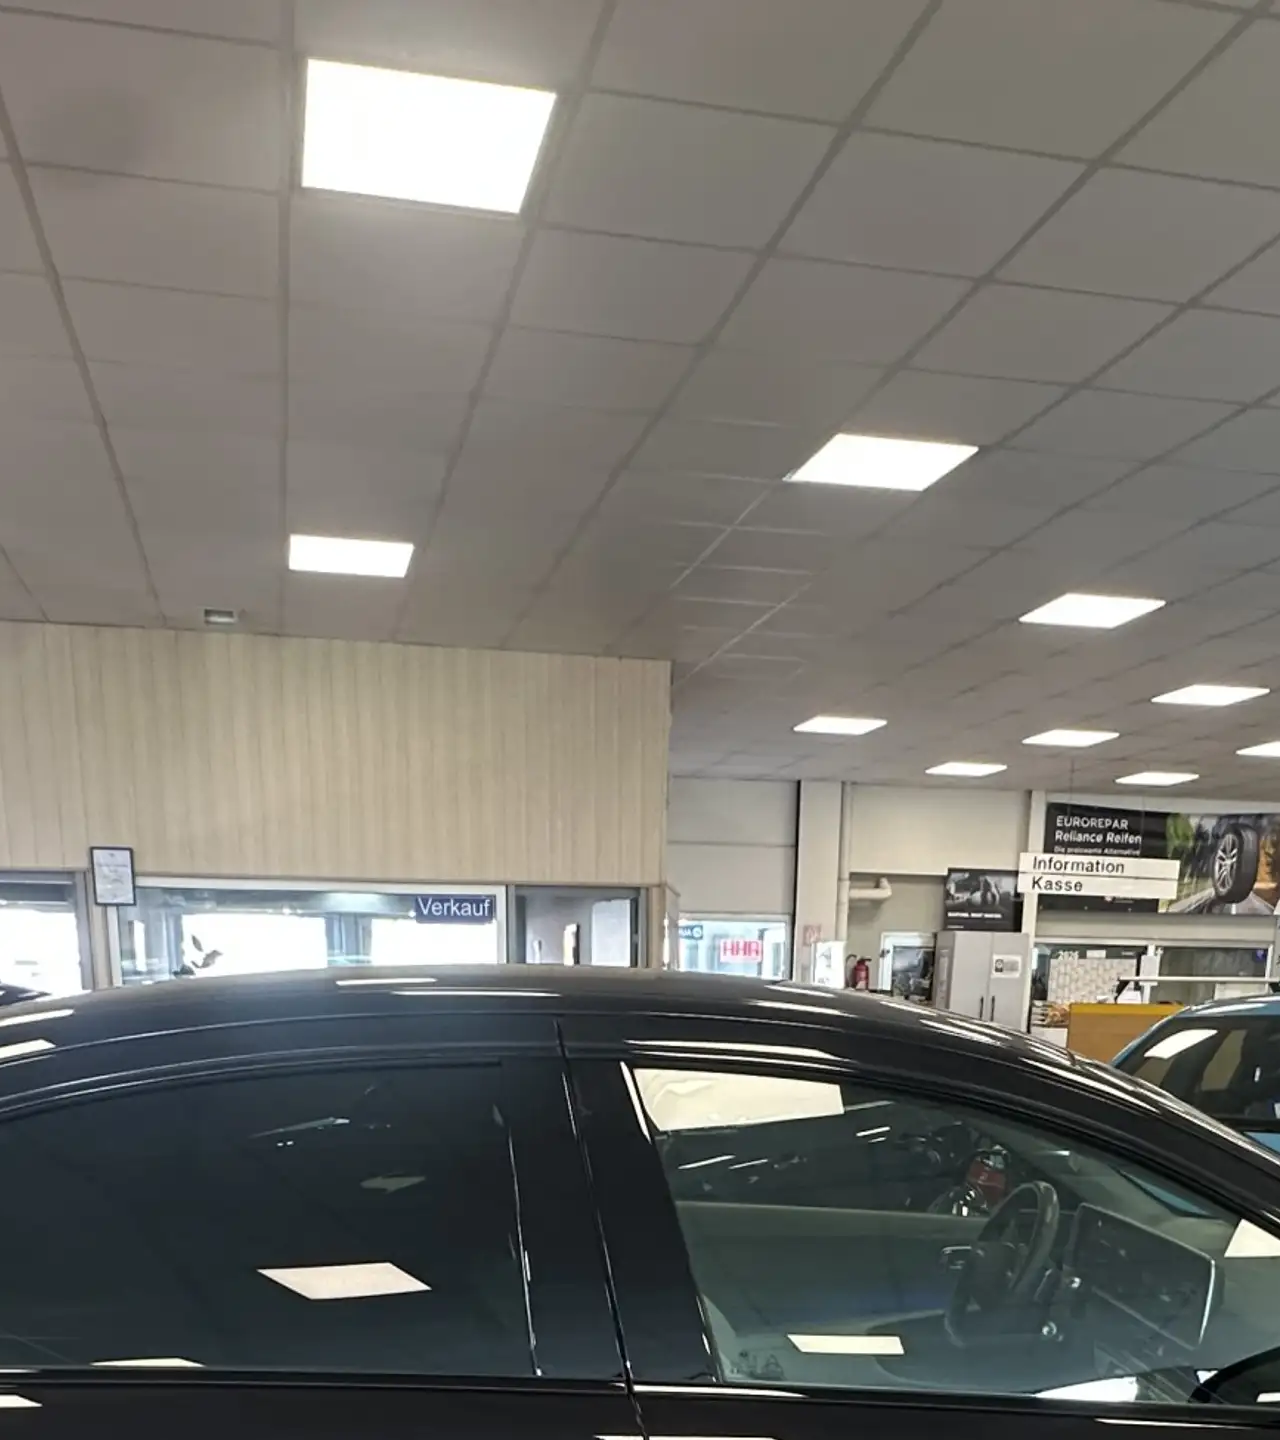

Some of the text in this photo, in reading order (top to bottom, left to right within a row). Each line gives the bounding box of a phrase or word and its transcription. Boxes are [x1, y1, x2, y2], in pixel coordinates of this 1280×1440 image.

[1056, 815, 1129, 830] EUROREPAR
[1055, 830, 1142, 845] Reliance Reifen
[1032, 855, 1125, 874] Information
[1031, 875, 1083, 892] Kasse
[417, 896, 491, 917] Verkauf
